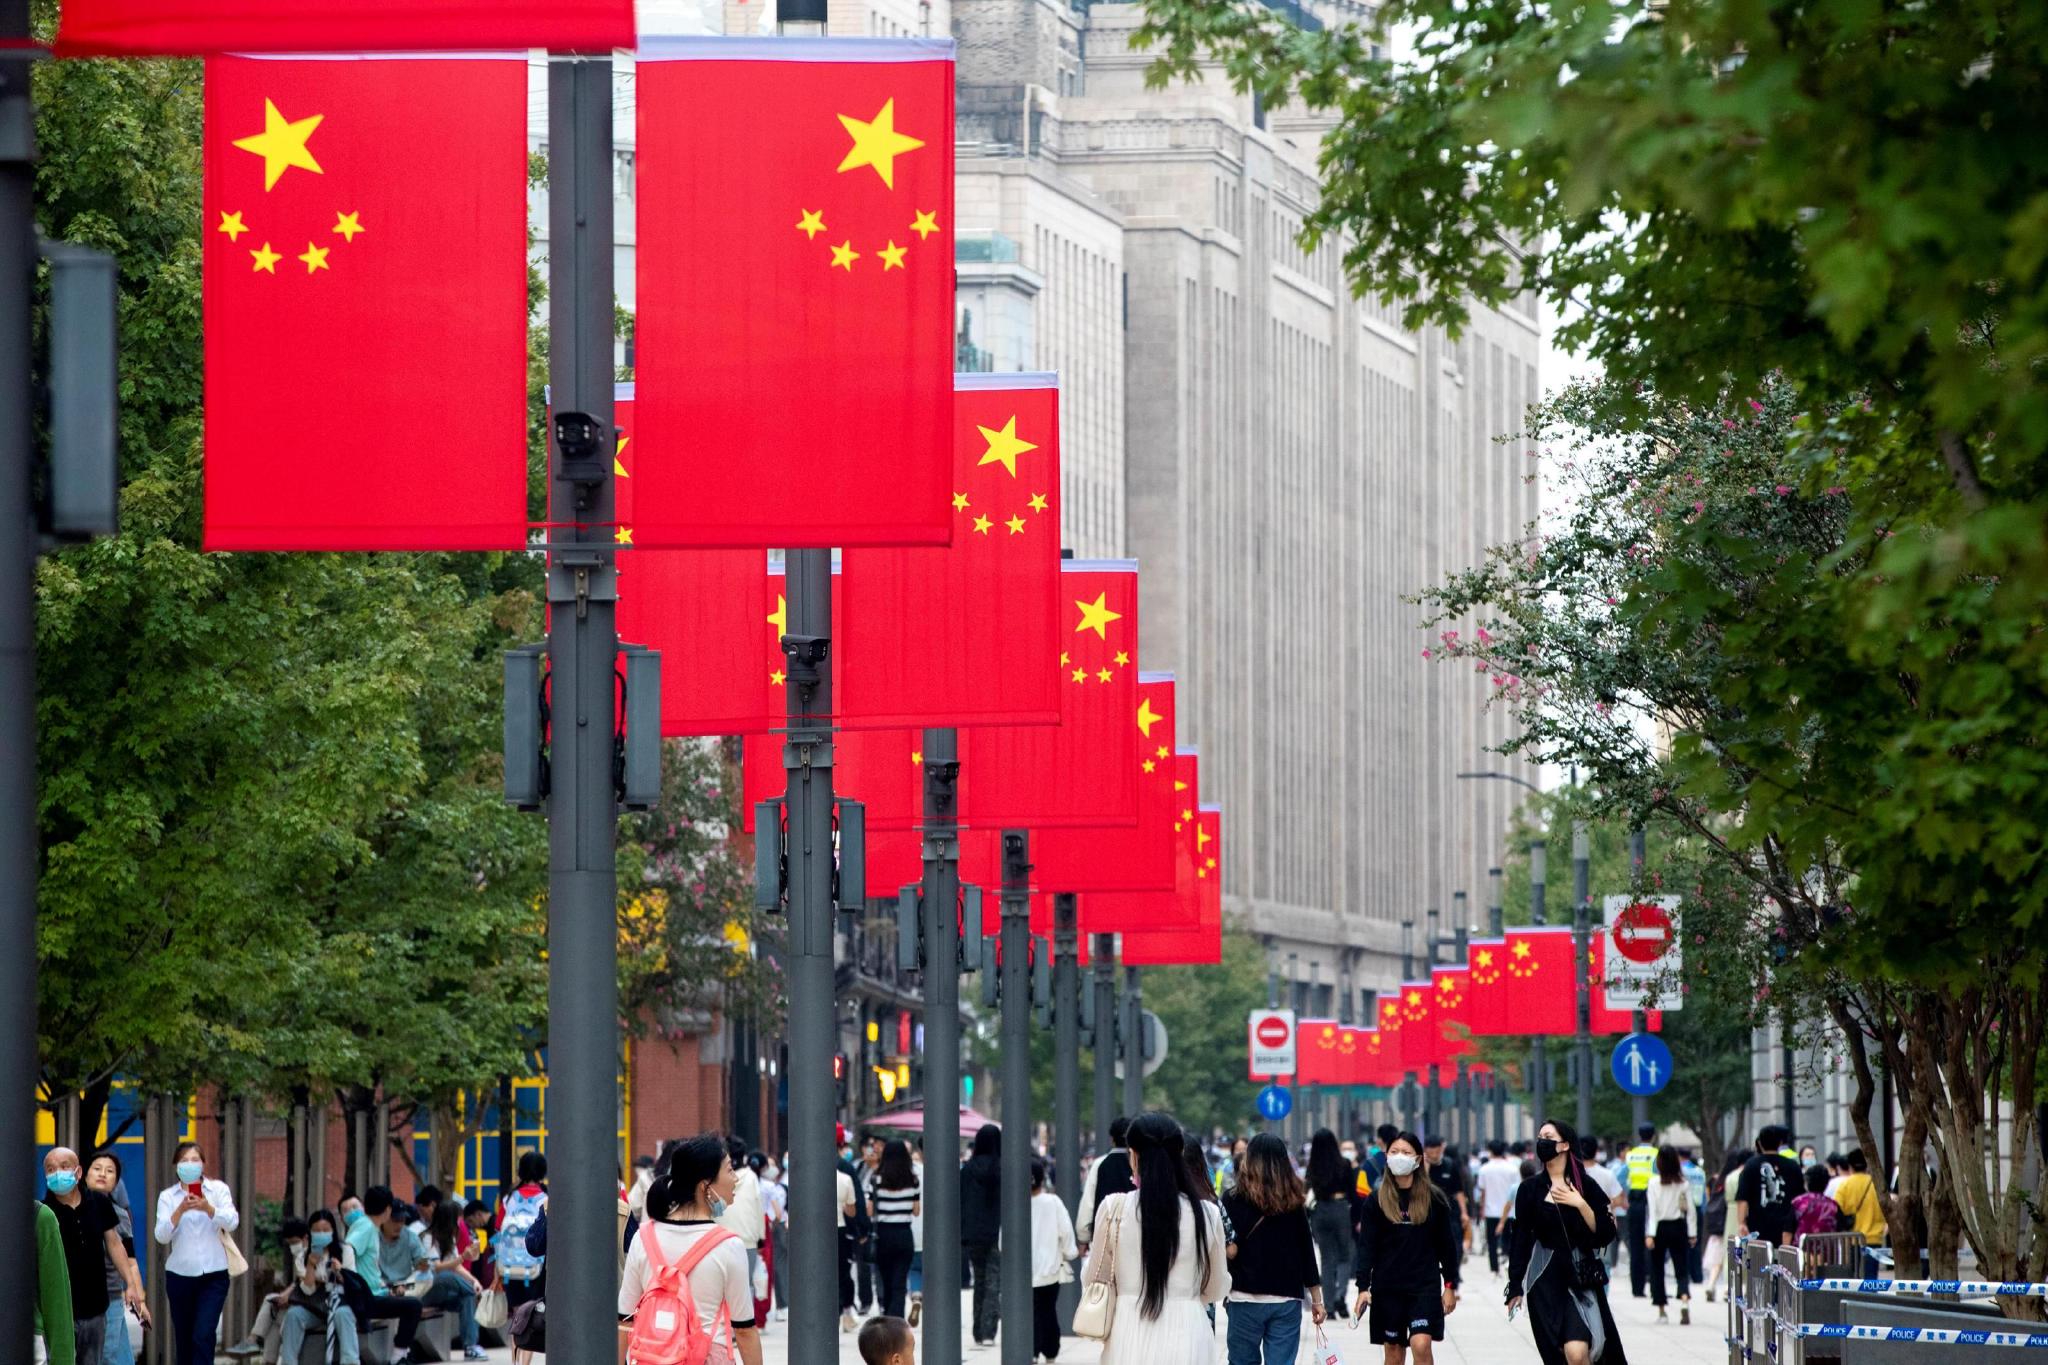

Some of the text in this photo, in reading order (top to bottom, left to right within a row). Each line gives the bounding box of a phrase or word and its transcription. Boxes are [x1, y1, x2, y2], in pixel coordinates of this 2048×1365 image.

[1863, 1281, 1887, 1290] POLICE
[1932, 1282, 1956, 1291] POLICE
[2002, 1284, 2026, 1293] POLICE
[1823, 1327, 1847, 1336] POLICE
[1892, 1330, 1915, 1339] POLICE
[1961, 1334, 1984, 1342] POLICE
